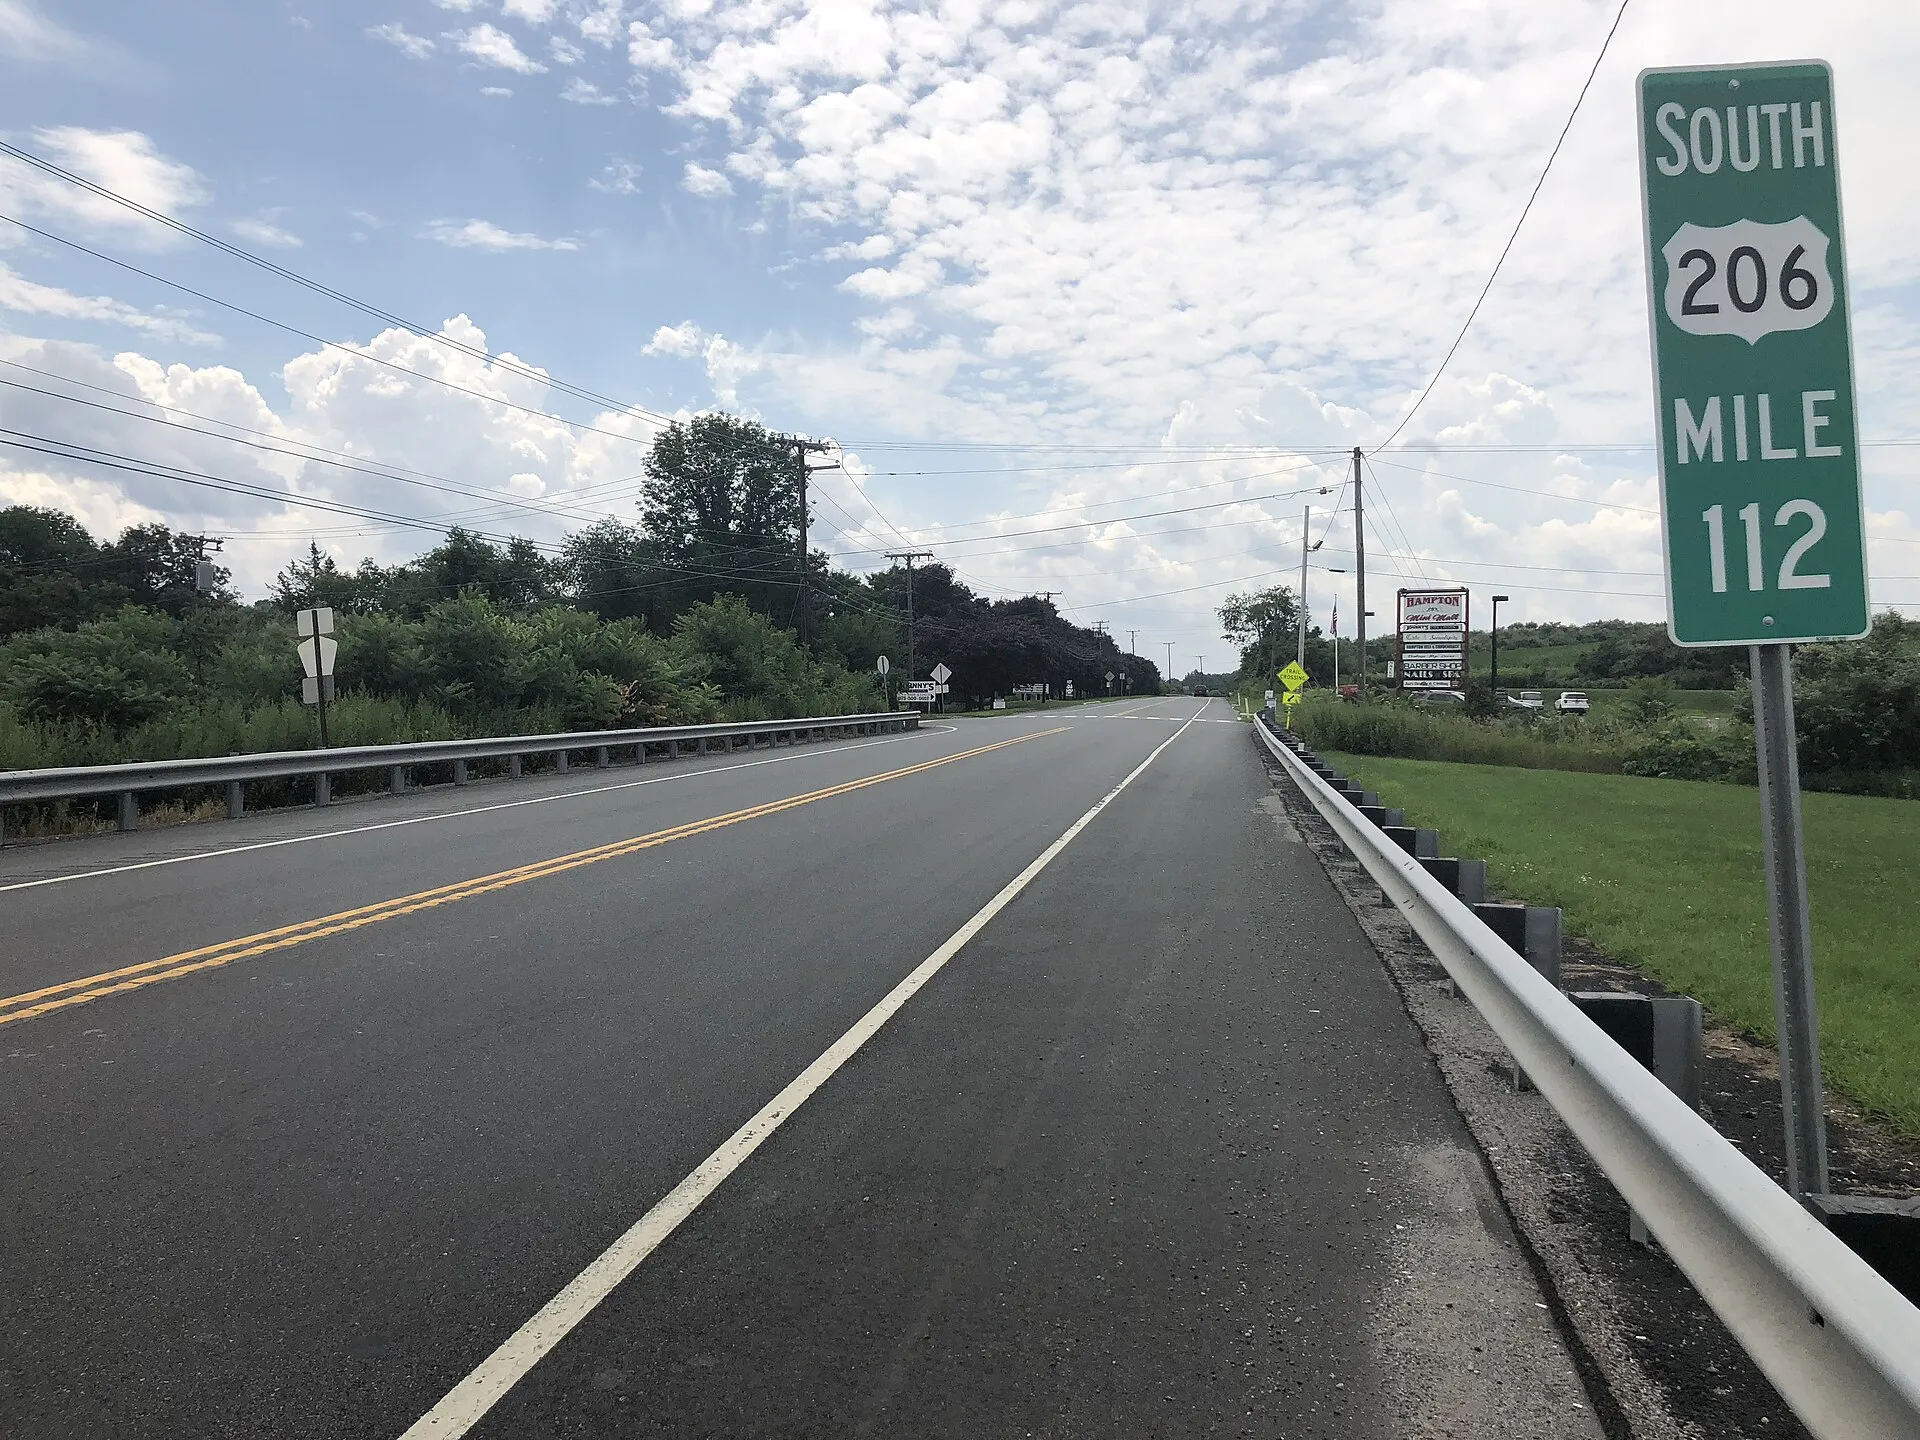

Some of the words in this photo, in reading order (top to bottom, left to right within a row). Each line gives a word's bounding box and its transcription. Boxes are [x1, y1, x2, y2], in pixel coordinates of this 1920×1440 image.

[1655, 101, 1826, 177] SOUTH
[1678, 243, 1819, 316] 206
[1674, 389, 1842, 465] MILE
[1702, 498, 1832, 593] 112
[1406, 597, 1460, 607] HAMPTON
[1406, 613, 1431, 622] Mini
[1432, 613, 1460, 622] Mall
[1404, 670, 1433, 678] NAILS
[1442, 670, 1461, 678] SPA
